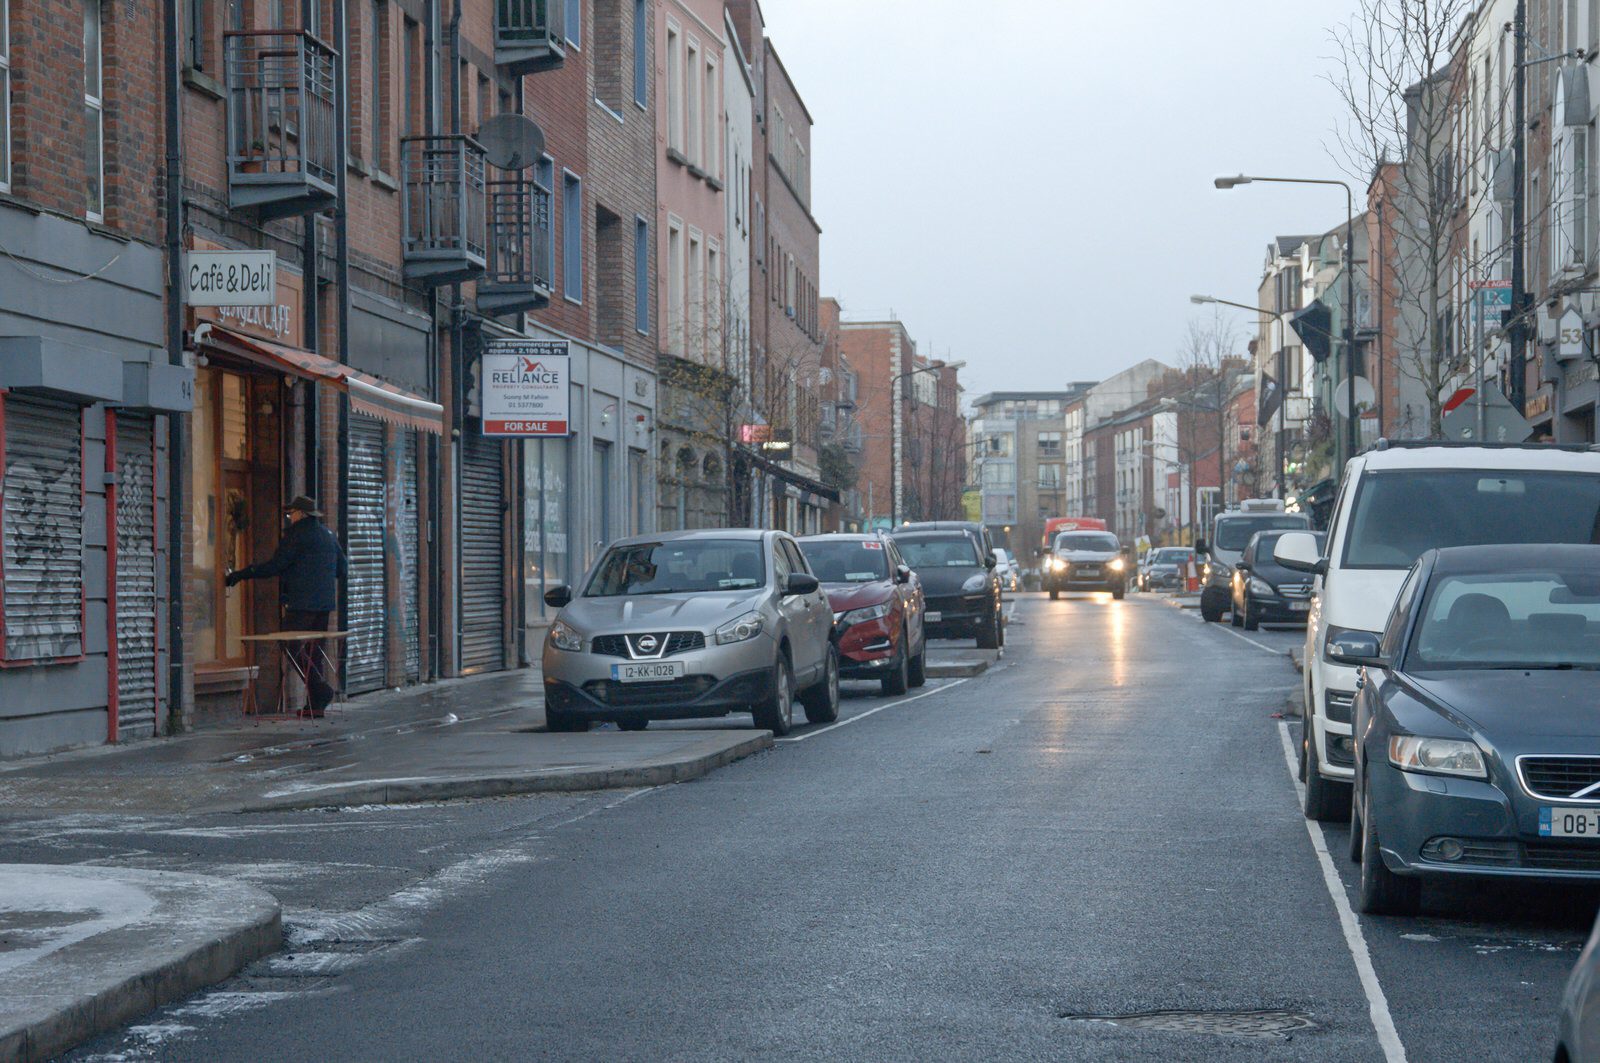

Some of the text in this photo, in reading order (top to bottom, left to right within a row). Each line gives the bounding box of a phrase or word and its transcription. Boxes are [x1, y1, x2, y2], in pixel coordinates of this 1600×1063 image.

[189, 263, 224, 292] Café
[240, 263, 271, 292] Deli
[1491, 280, 1513, 288] AGRE
[1561, 328, 1581, 344] 53
[492, 369, 559, 384] RELIANCE
[181, 380, 191, 399] 94
[504, 422, 548, 431] FOR SALE
[625, 665, 674, 678] 12-KK-1028
